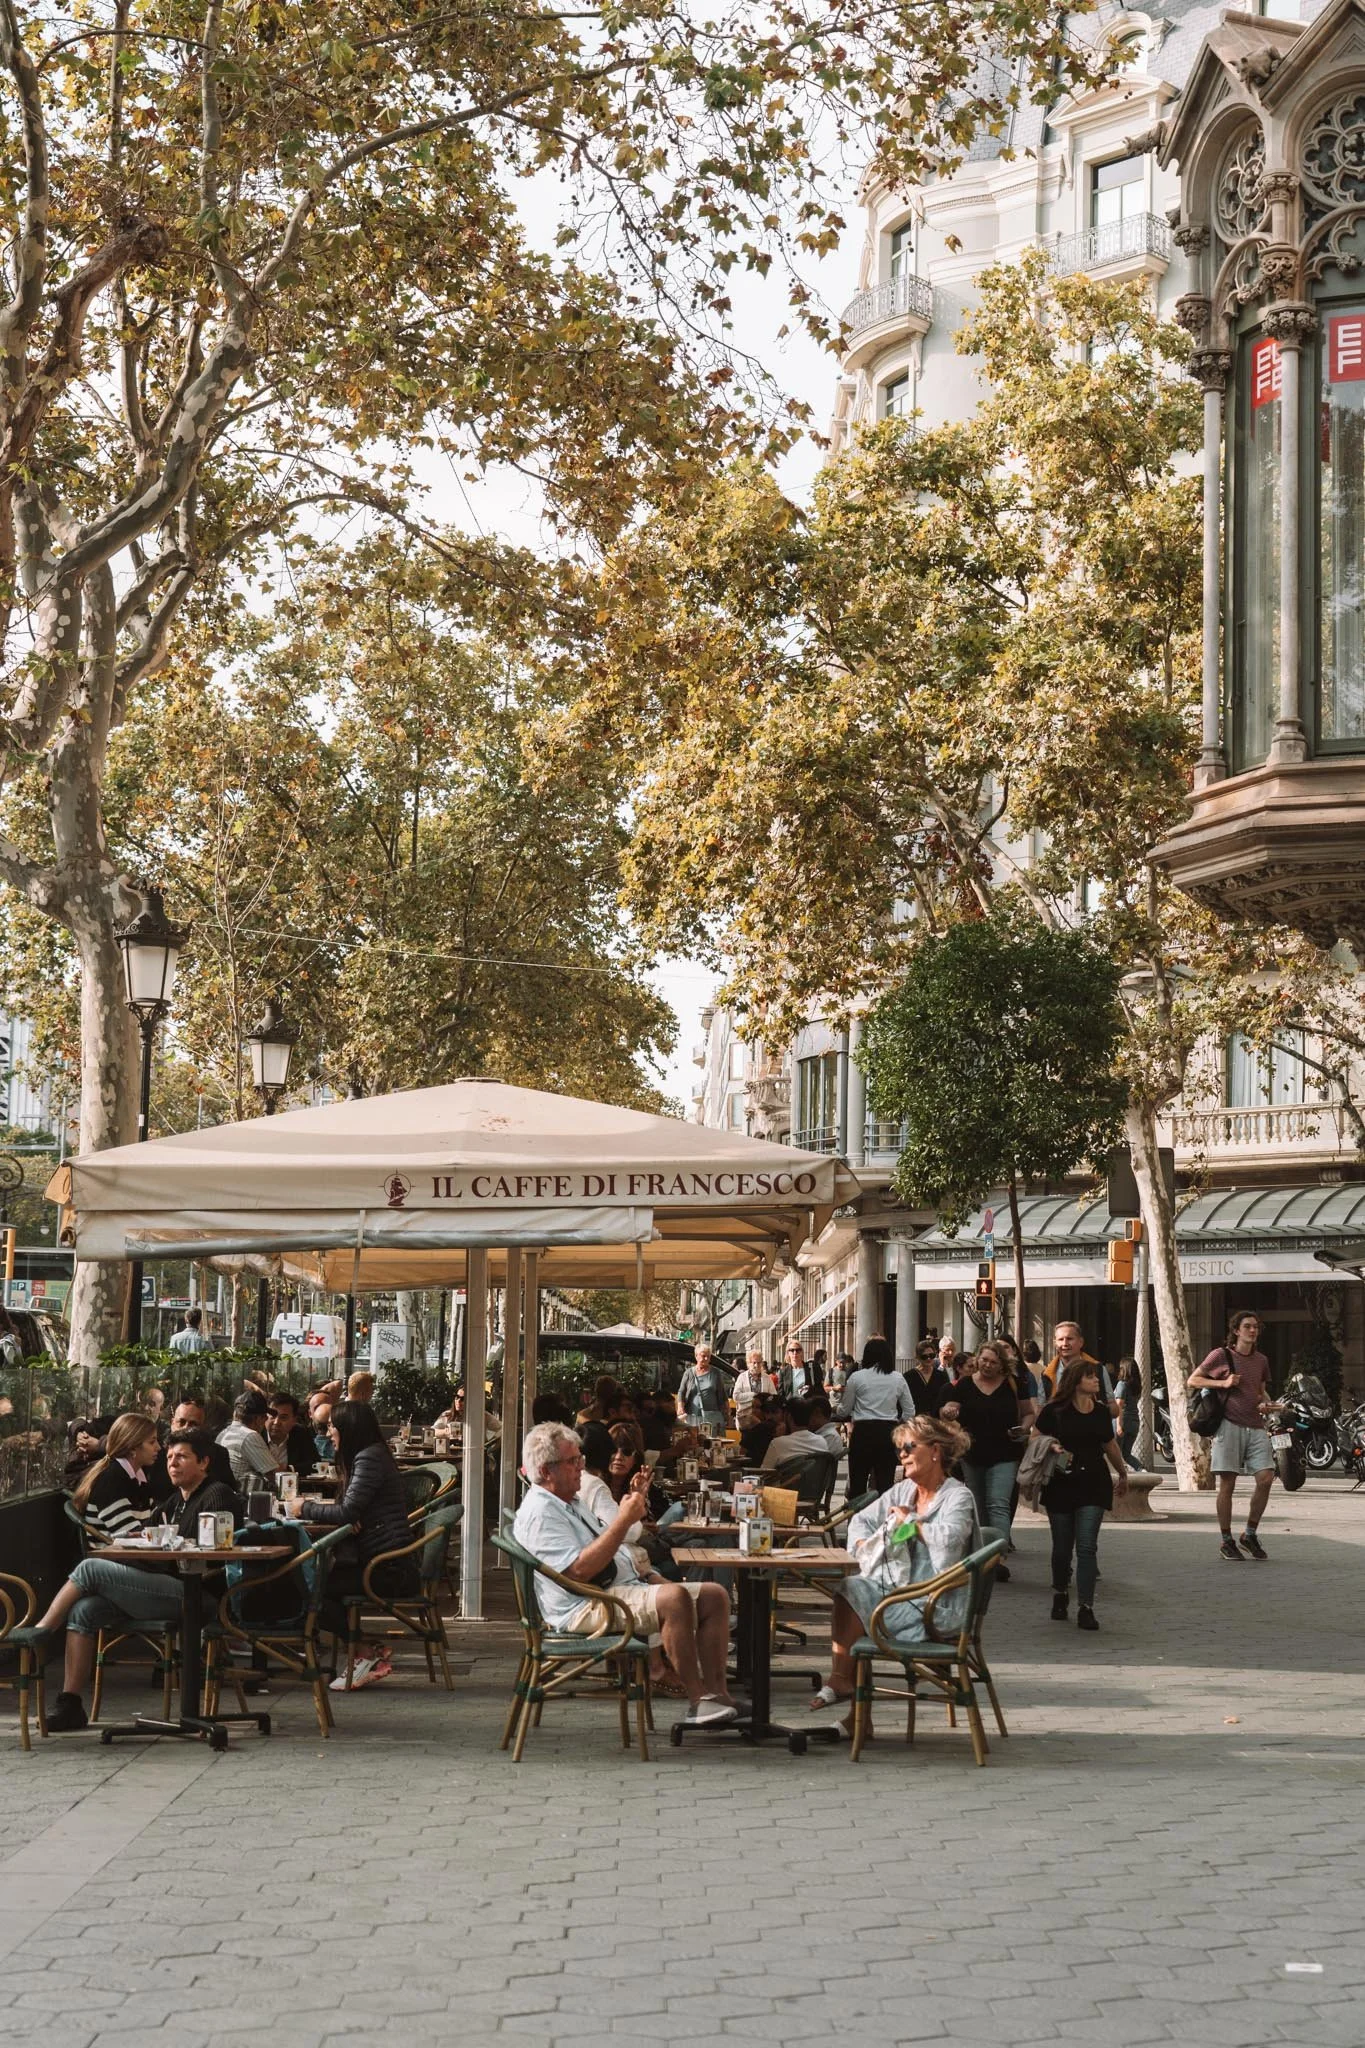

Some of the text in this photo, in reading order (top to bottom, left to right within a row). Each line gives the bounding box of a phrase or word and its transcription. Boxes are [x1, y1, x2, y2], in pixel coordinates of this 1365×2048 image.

[431, 1173, 817, 1198] IL CAFFE DI FRANCESCO
[1182, 1260, 1234, 1278] JESTIC
[279, 1329, 325, 1346] FedEx
